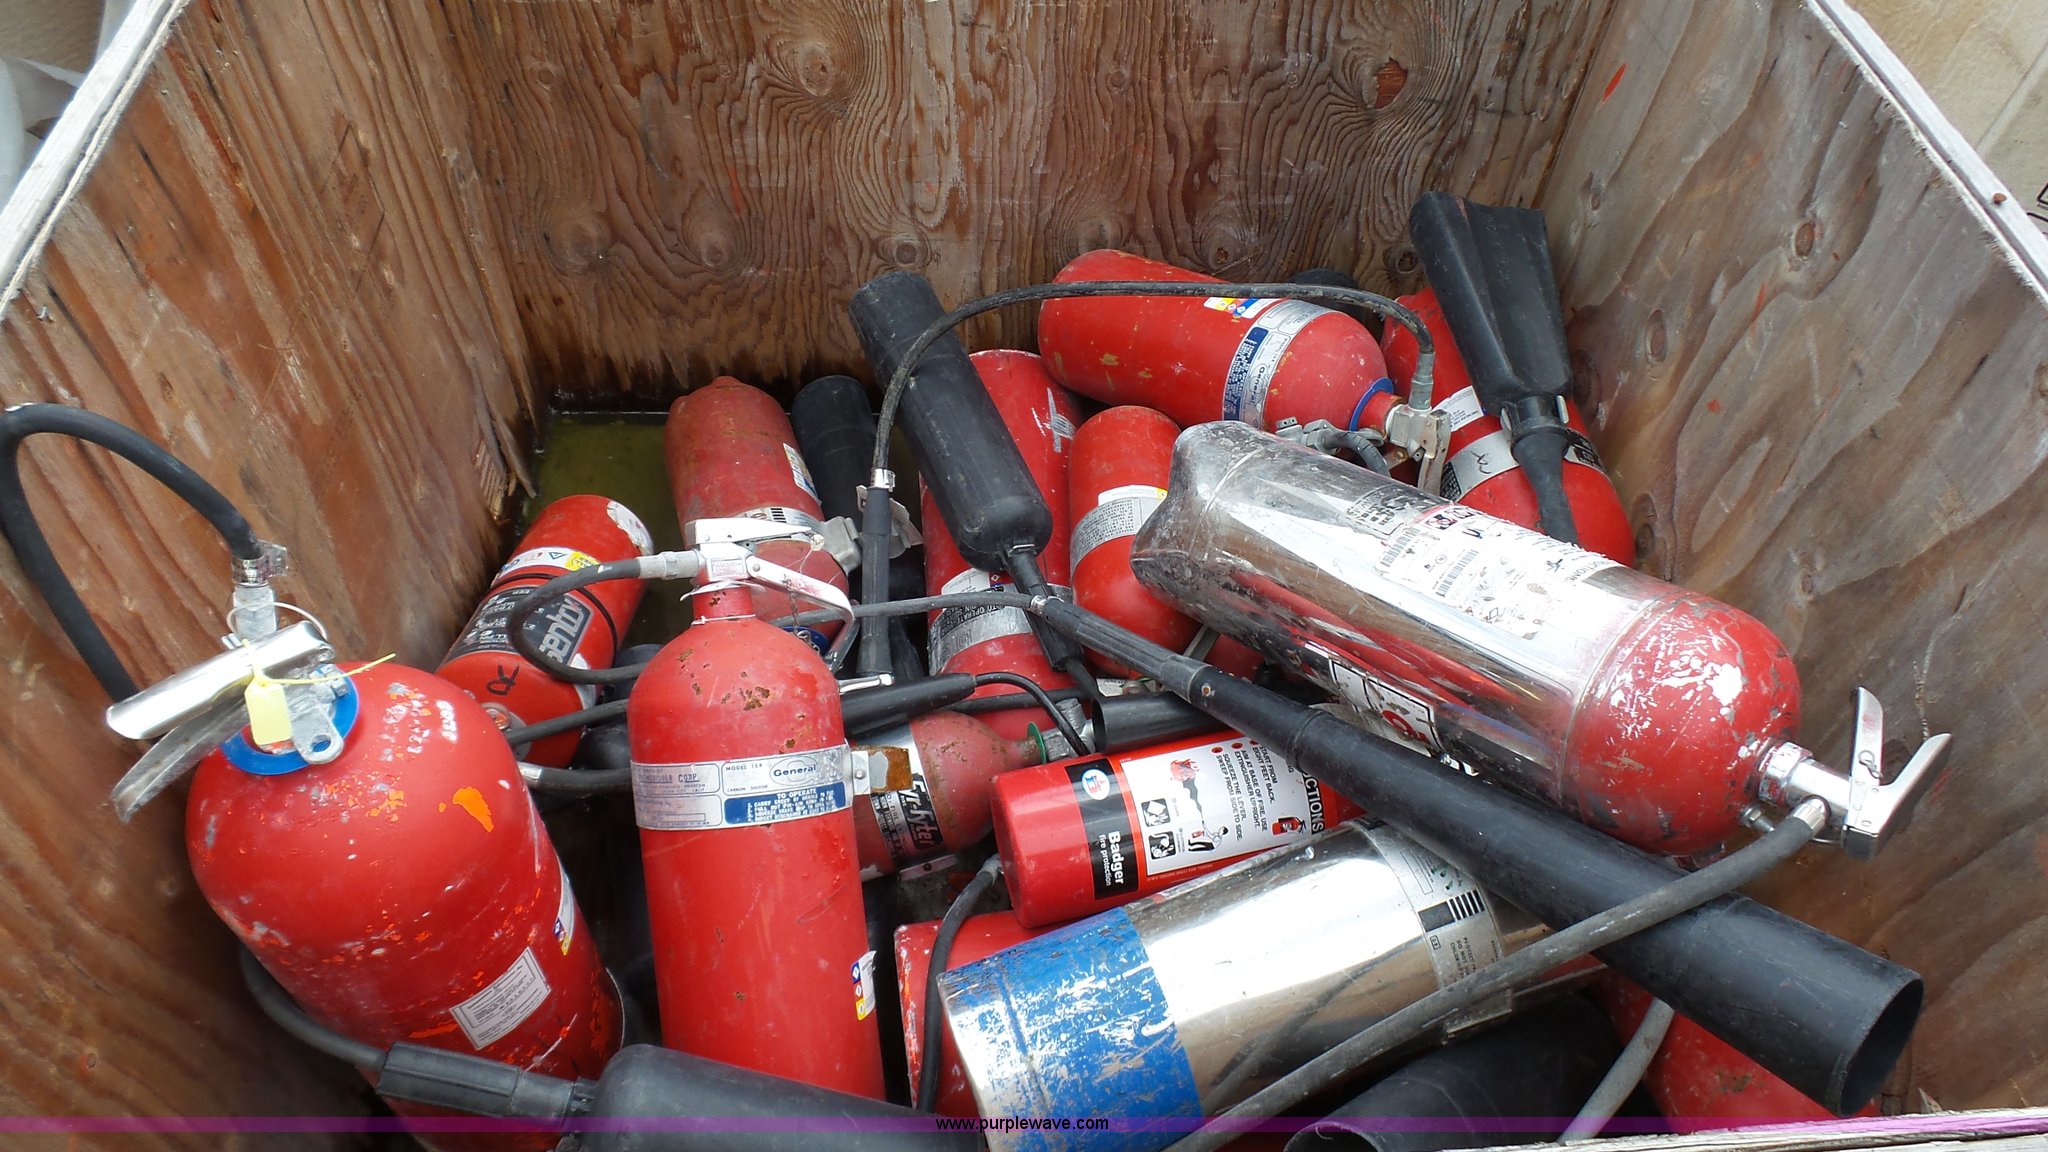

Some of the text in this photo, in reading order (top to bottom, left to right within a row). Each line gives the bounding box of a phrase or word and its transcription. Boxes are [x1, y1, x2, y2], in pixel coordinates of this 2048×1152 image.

[774, 764, 816, 777] General
[1223, 753, 1237, 780] SQUEEZE
[1234, 750, 1253, 796] EXTINGUISHER
[1245, 760, 1253, 768] AT
[1249, 769, 1259, 787] BASE
[1255, 787, 1262, 799] OF
[1253, 747, 1275, 804] EIGHT FEET BACK.
[1259, 745, 1277, 783] START FROM
[1216, 754, 1228, 776] SWEEP
[1224, 776, 1234, 796] FROM
[1230, 796, 1238, 813] SIDE
[1234, 813, 1240, 823] TO
[1099, 833, 1112, 886] fire protection
[1108, 829, 1124, 885] Badger
